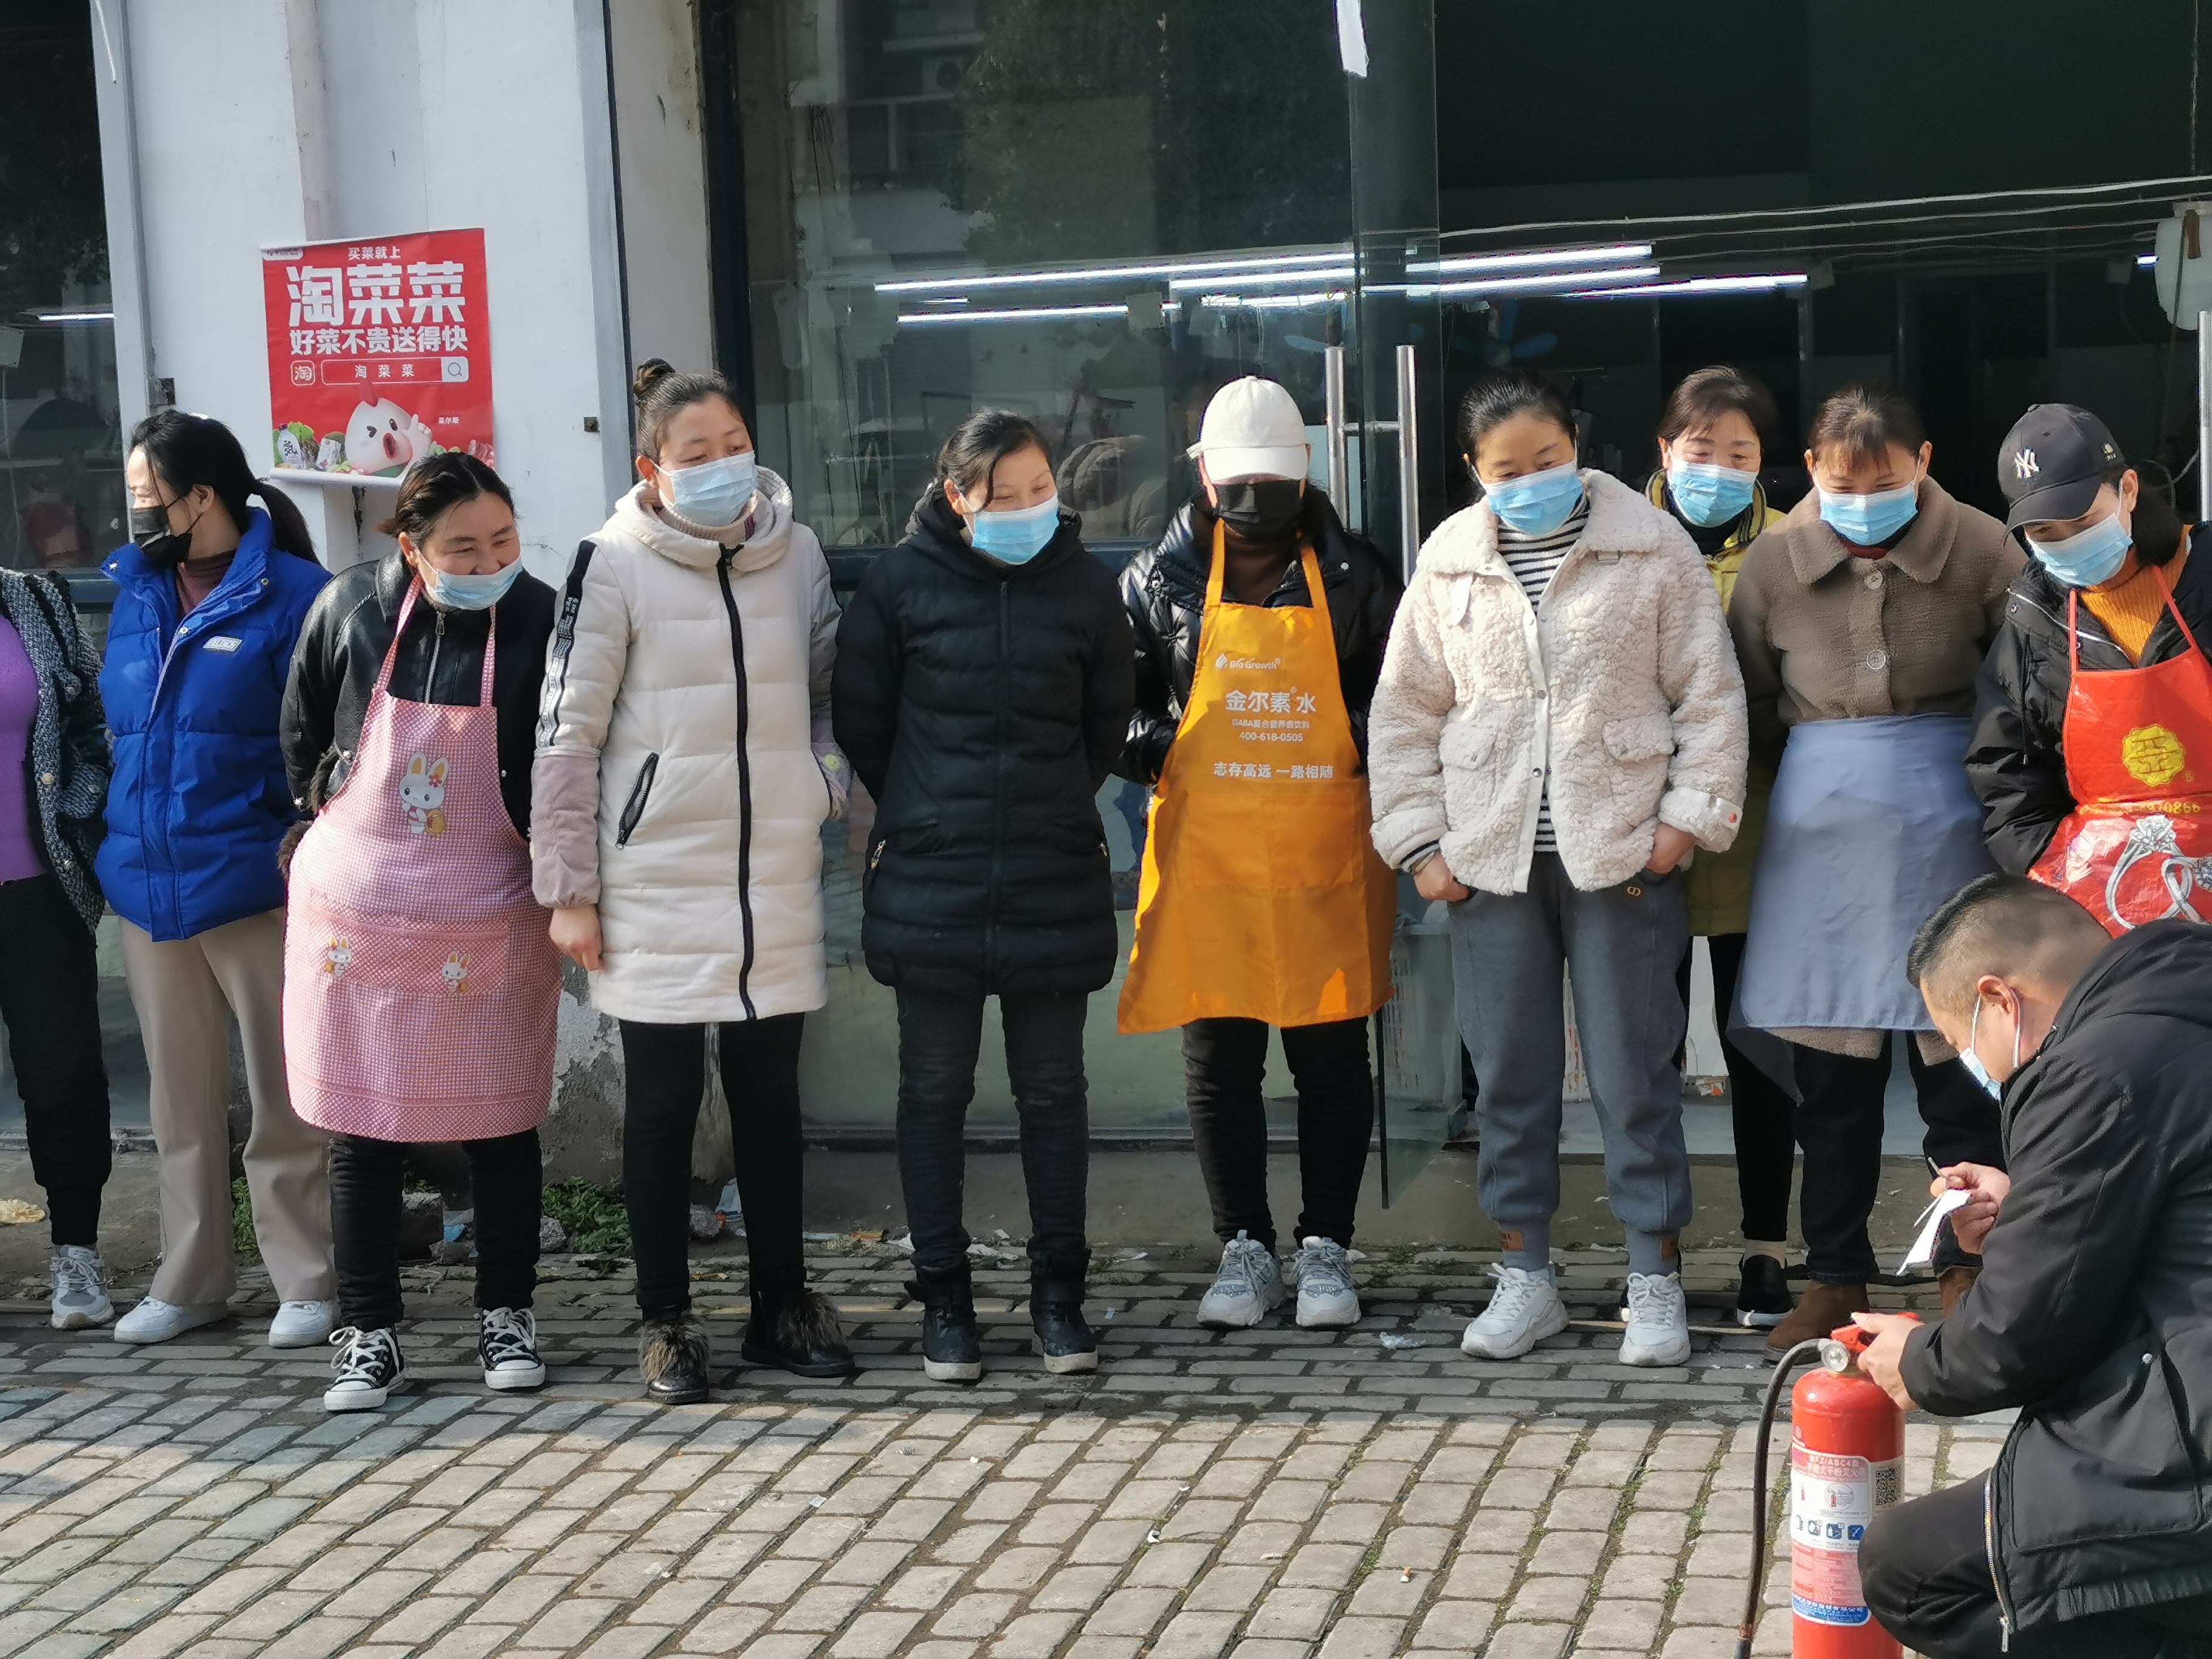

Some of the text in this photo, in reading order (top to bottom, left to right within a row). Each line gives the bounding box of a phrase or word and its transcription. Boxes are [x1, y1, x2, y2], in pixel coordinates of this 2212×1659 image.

[348, 246, 401, 261] 买菜就上
[286, 261, 466, 327] 淘菜菜
[290, 325, 468, 355] 好菜不贵送得快
[295, 365, 313, 381] 淘
[1230, 658, 1277, 669] Bio Growth
[1239, 731, 1304, 742] 400-618-0505
[1213, 761, 1333, 779] 志存高远 一路相随
